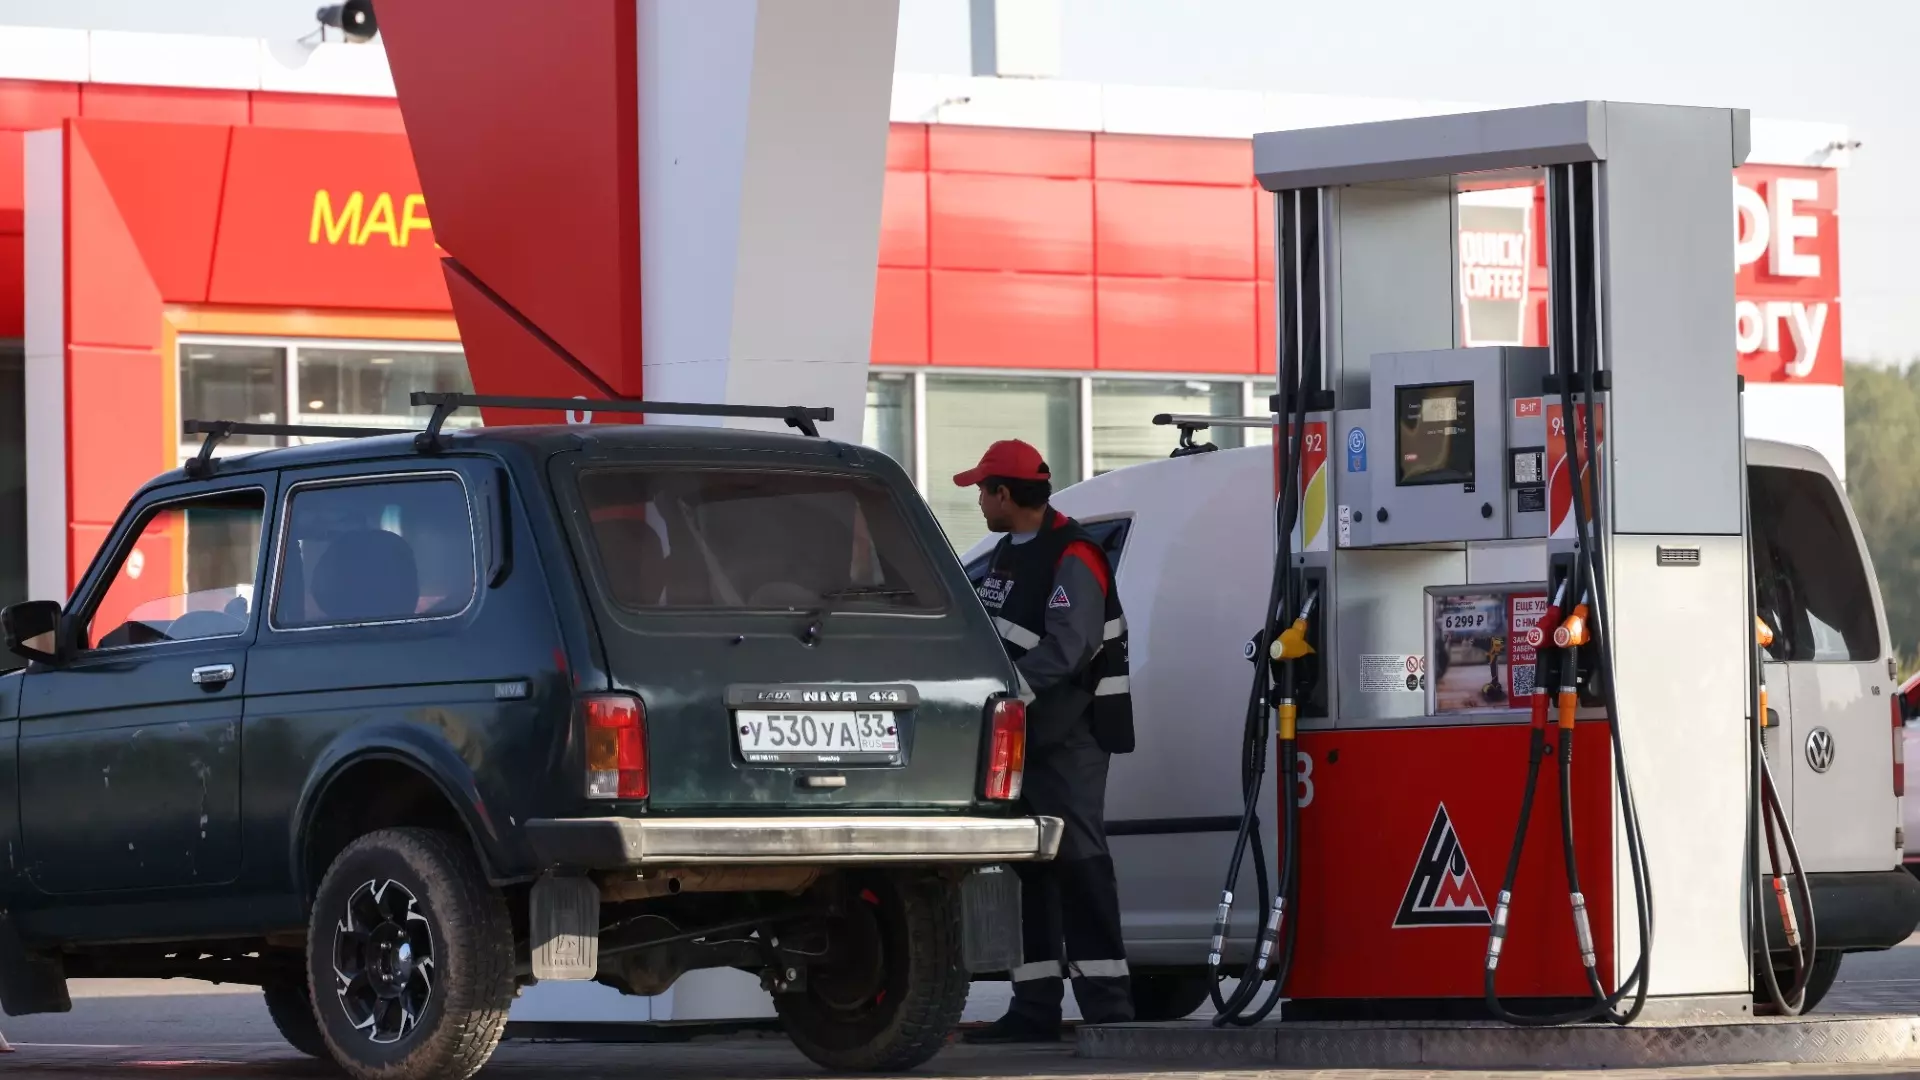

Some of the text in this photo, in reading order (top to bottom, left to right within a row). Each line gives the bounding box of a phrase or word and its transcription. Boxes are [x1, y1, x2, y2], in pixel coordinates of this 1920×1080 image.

[1461, 231, 1524, 267] QUICK
[1465, 266, 1522, 299] COFFEE
[1305, 433, 1322, 452] 92
[1535, 601, 1547, 611] УД
[1445, 616, 1453, 629] 6
[1454, 615, 1474, 629] 299
[1529, 632, 1540, 641] 95
[496, 683, 526, 697] NIVA
[758, 692, 792, 700] LADA
[803, 691, 858, 701] NIVA
[859, 713, 887, 738] 33
[861, 739, 882, 749] RUS
